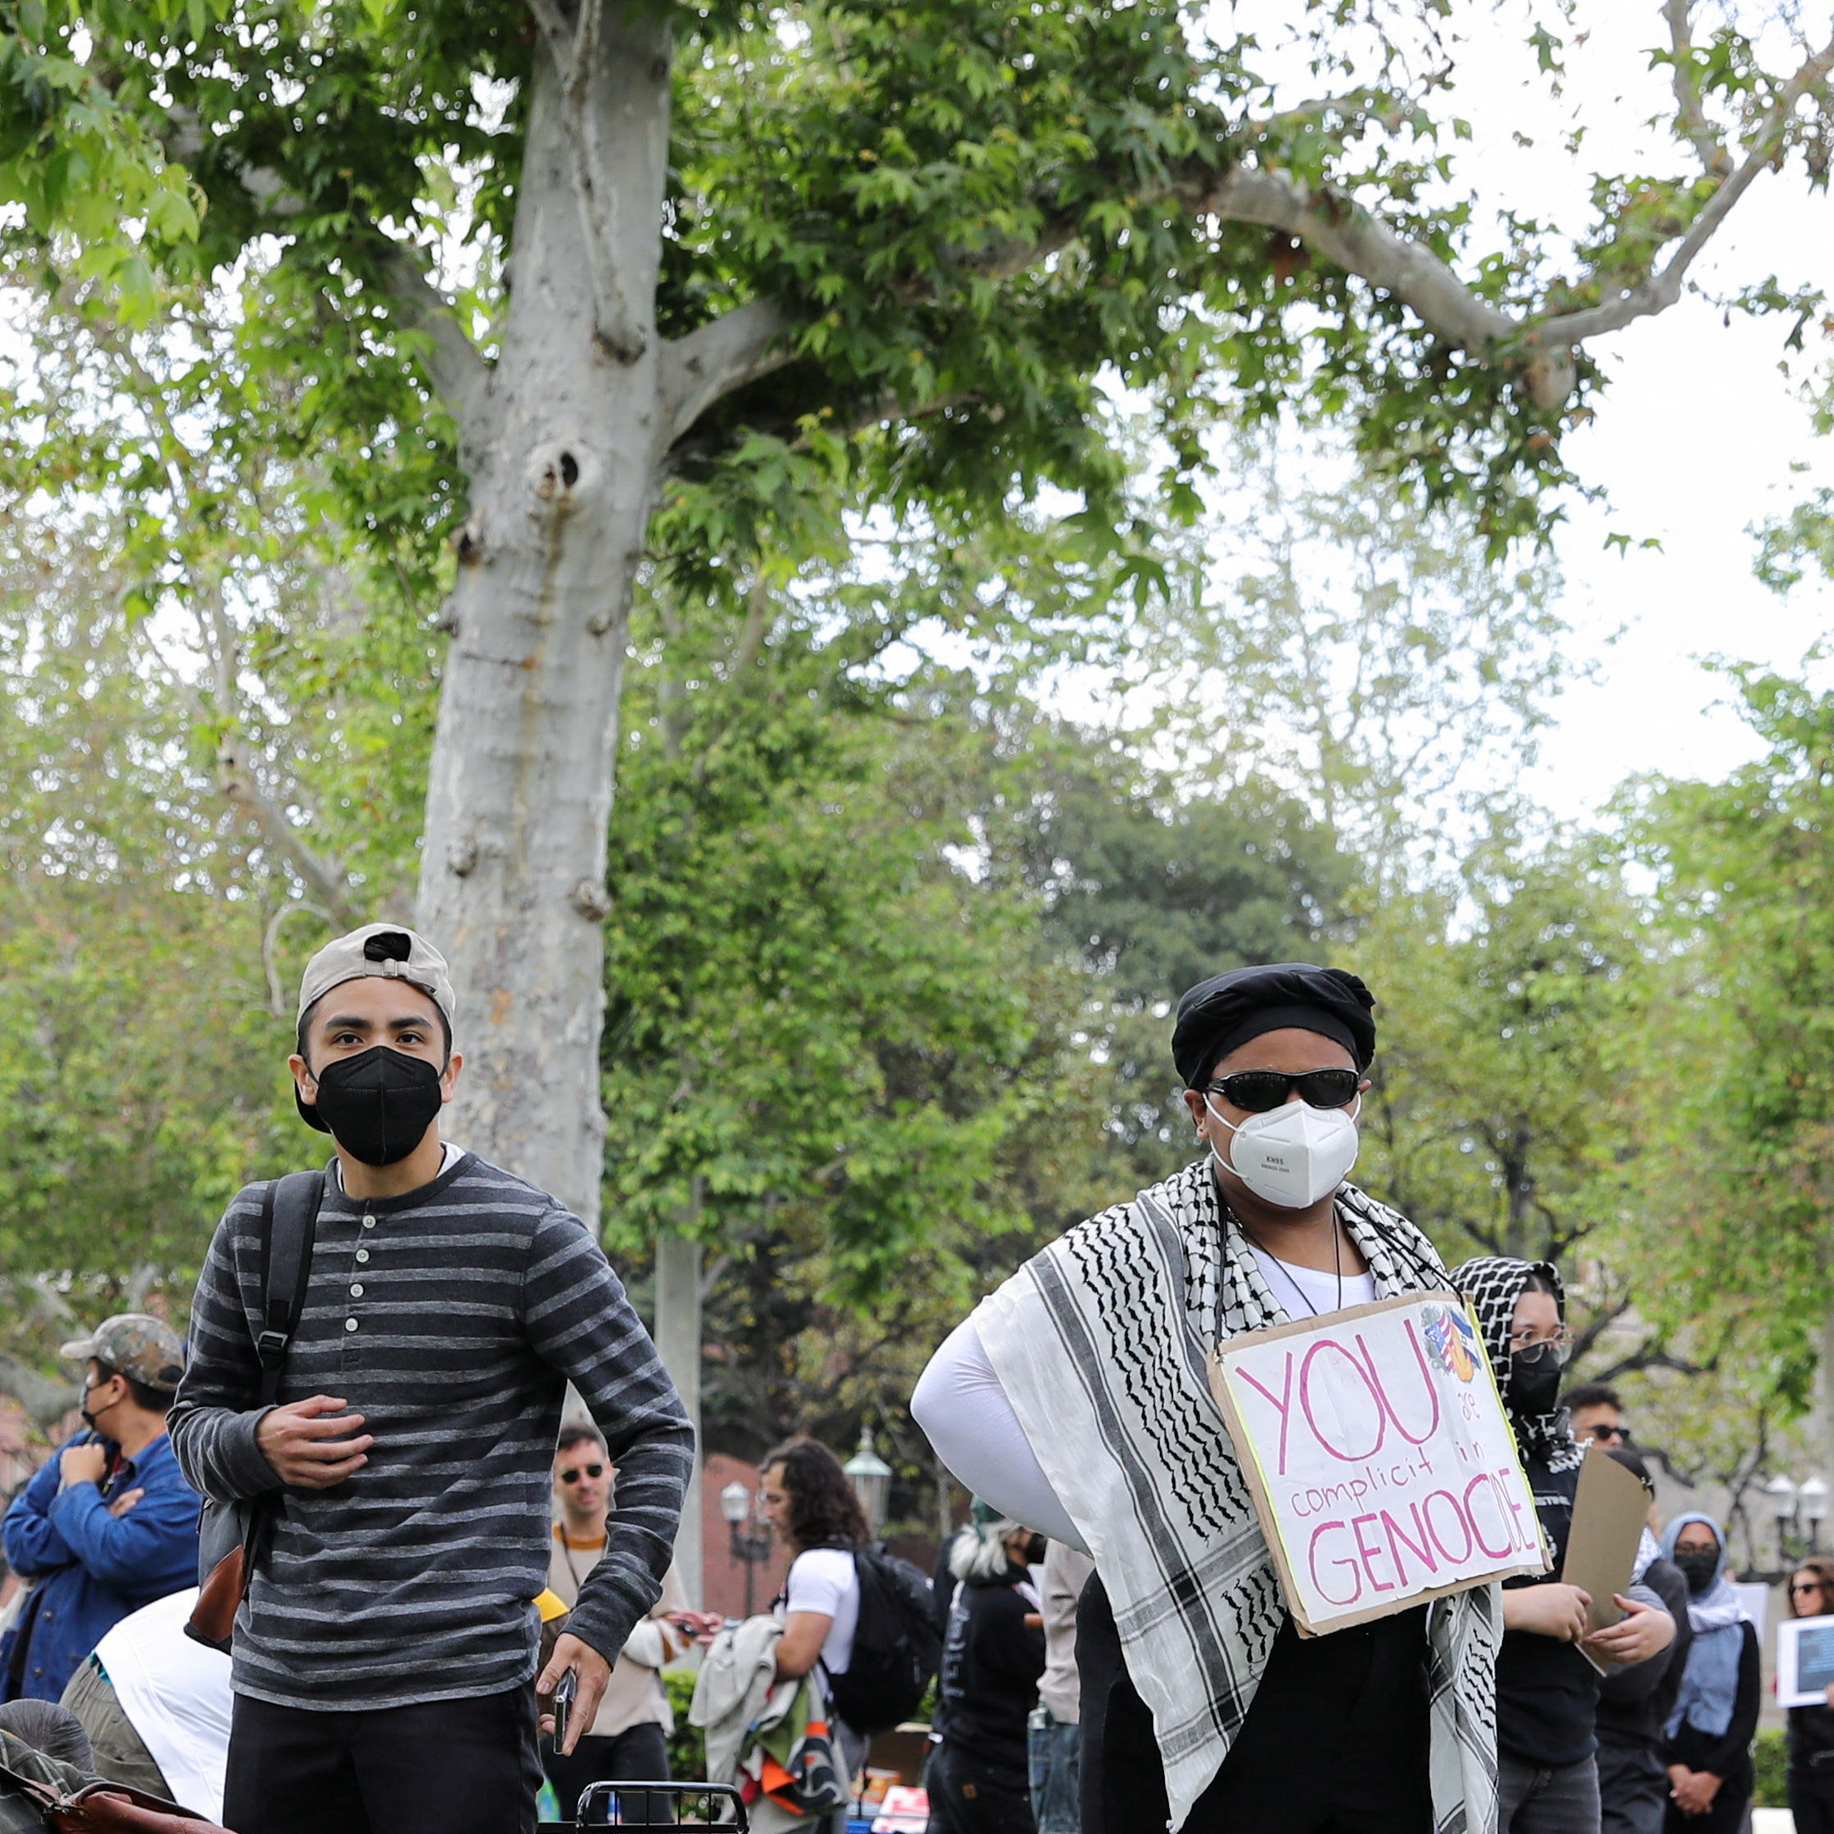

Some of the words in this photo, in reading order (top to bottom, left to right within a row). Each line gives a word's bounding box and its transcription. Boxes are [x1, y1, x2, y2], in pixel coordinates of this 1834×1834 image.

[1235, 1318, 1441, 1477] YOU
[1291, 1447, 1434, 1519] complicit
[1455, 1440, 1486, 1463] in
[1308, 1468, 1537, 1606] GENOCIDE
